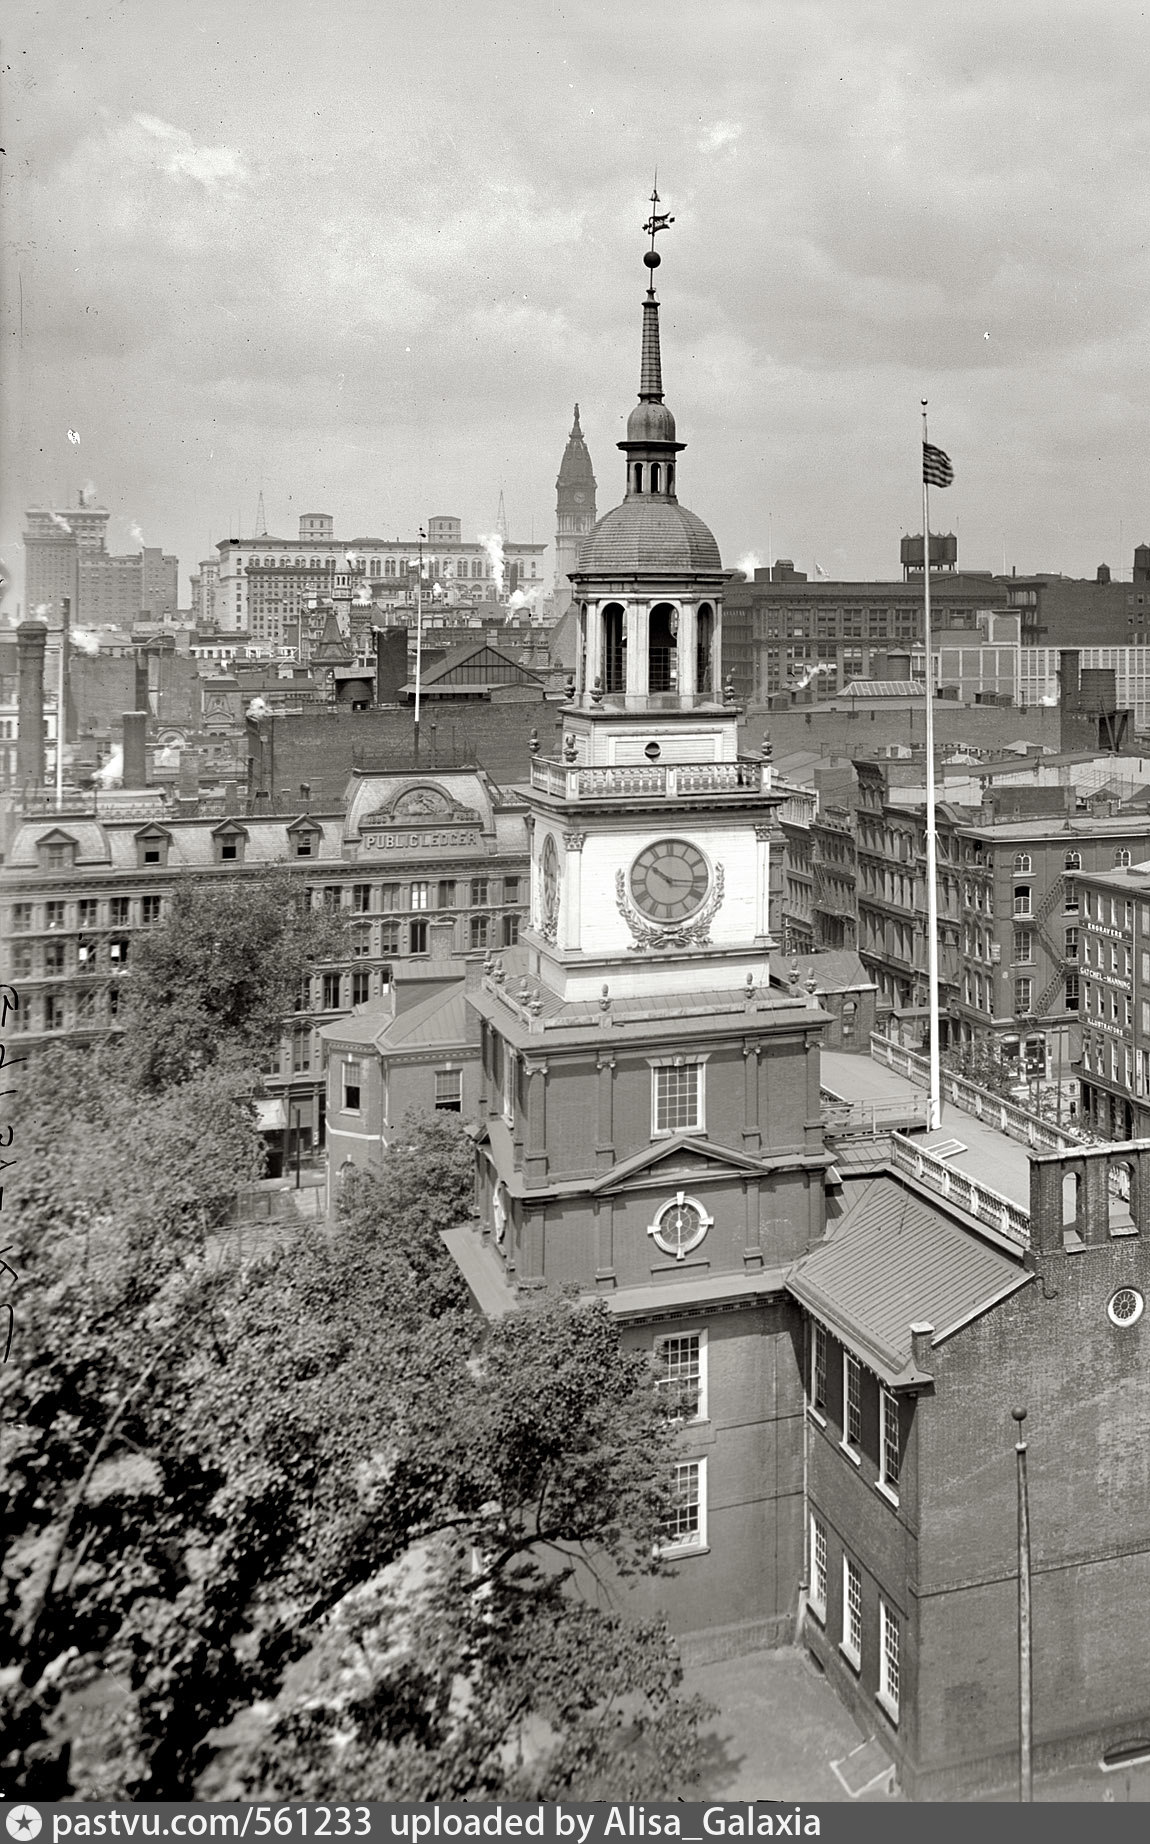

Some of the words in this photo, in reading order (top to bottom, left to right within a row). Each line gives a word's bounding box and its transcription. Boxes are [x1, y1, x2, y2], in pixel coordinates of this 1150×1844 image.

[366, 834, 419, 850] PUBLIC
[420, 831, 477, 848] LEDGER
[1088, 922, 1122, 939] ENGRAVERS
[1087, 1017, 1123, 1036] ILLUSTRATORS
